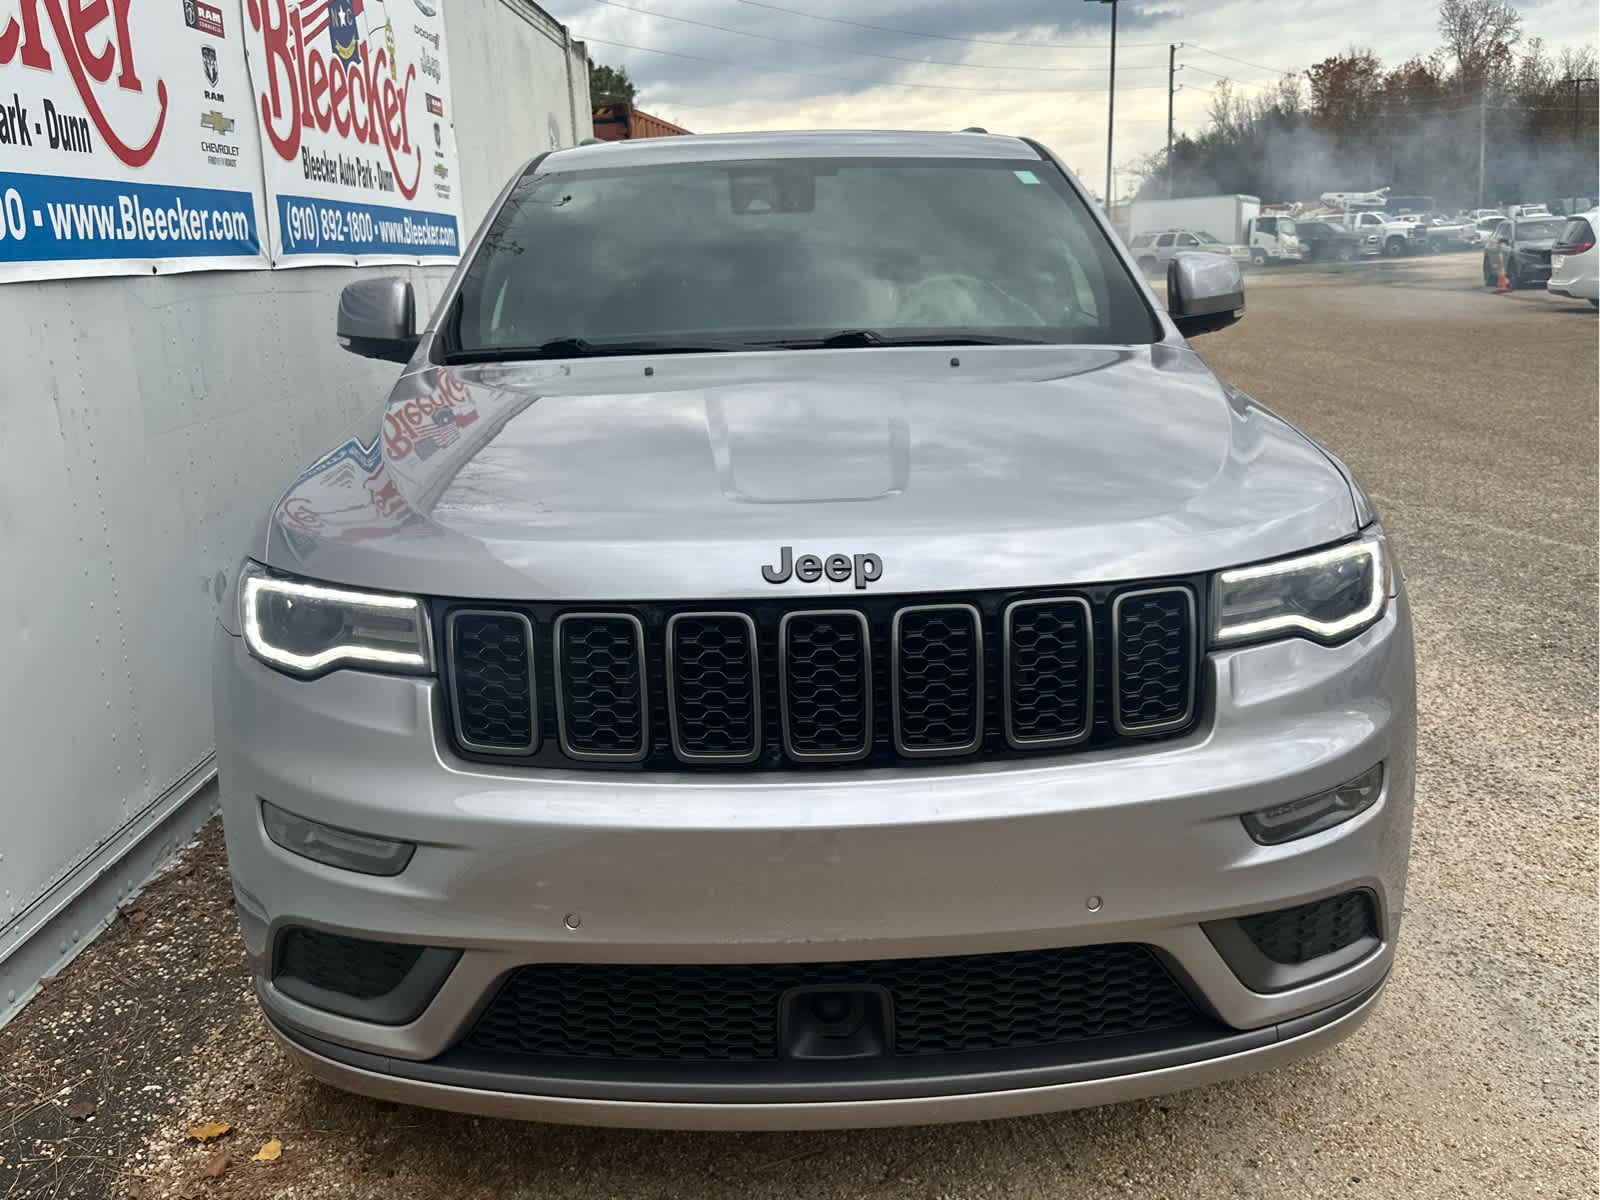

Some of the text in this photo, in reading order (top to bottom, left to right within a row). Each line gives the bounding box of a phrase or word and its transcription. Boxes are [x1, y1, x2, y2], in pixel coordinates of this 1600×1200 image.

[197, 6, 222, 24] RAM
[204, 90, 225, 103] RAM
[248, 0, 421, 200] Bleecker
[43, 98, 93, 153] Dunn
[201, 141, 240, 157] CHEVROLET
[301, 145, 338, 184] Bleecker
[339, 153, 356, 187] Auto
[356, 157, 374, 189] Park
[377, 161, 395, 192] Dunn
[47, 194, 249, 241] www.Bleecker.com
[286, 201, 457, 248] (910) 892-1800 www.Bleecker.com
[761, 546, 883, 590] Jeep
